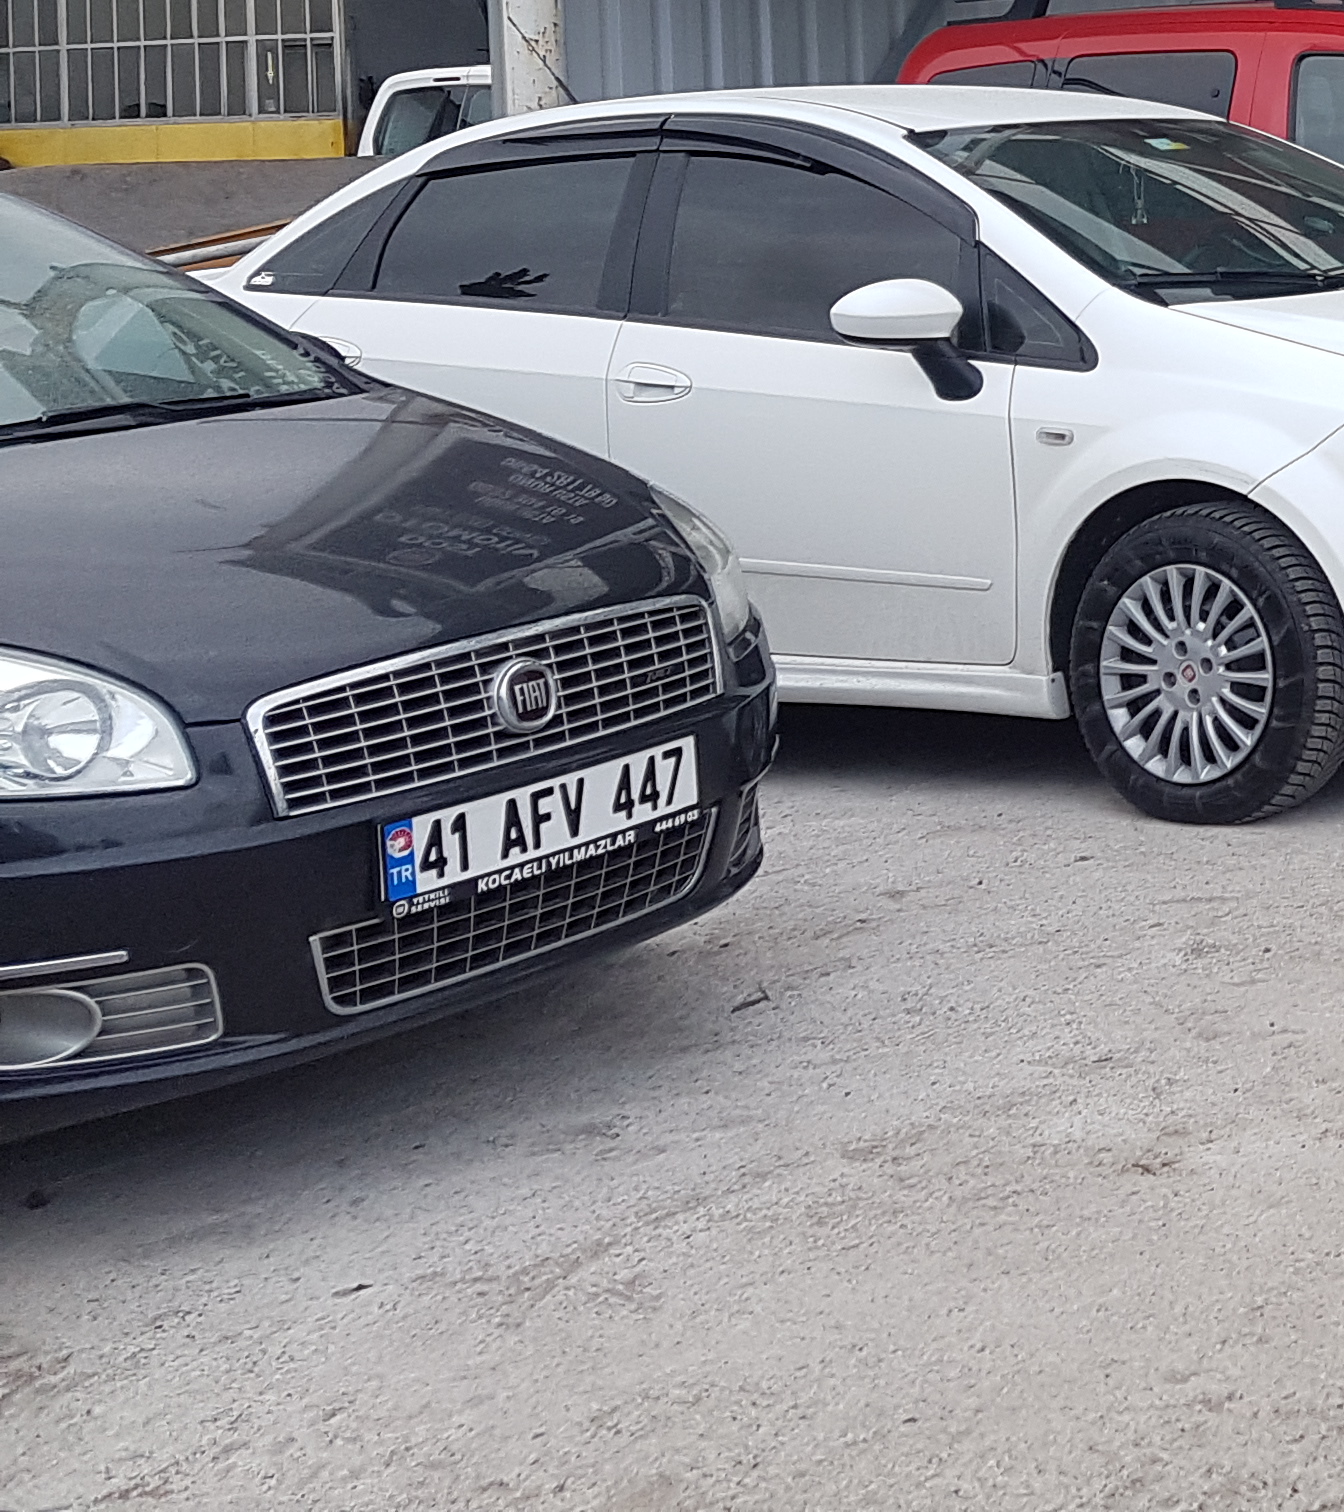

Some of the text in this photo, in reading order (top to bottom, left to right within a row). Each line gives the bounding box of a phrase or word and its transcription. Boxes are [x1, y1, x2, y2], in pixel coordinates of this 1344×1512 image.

[514, 678, 548, 714] FIAT
[419, 745, 683, 880] 41 AFV 447
[548, 829, 636, 871] YILMAZLAR
[389, 864, 414, 886] TR
